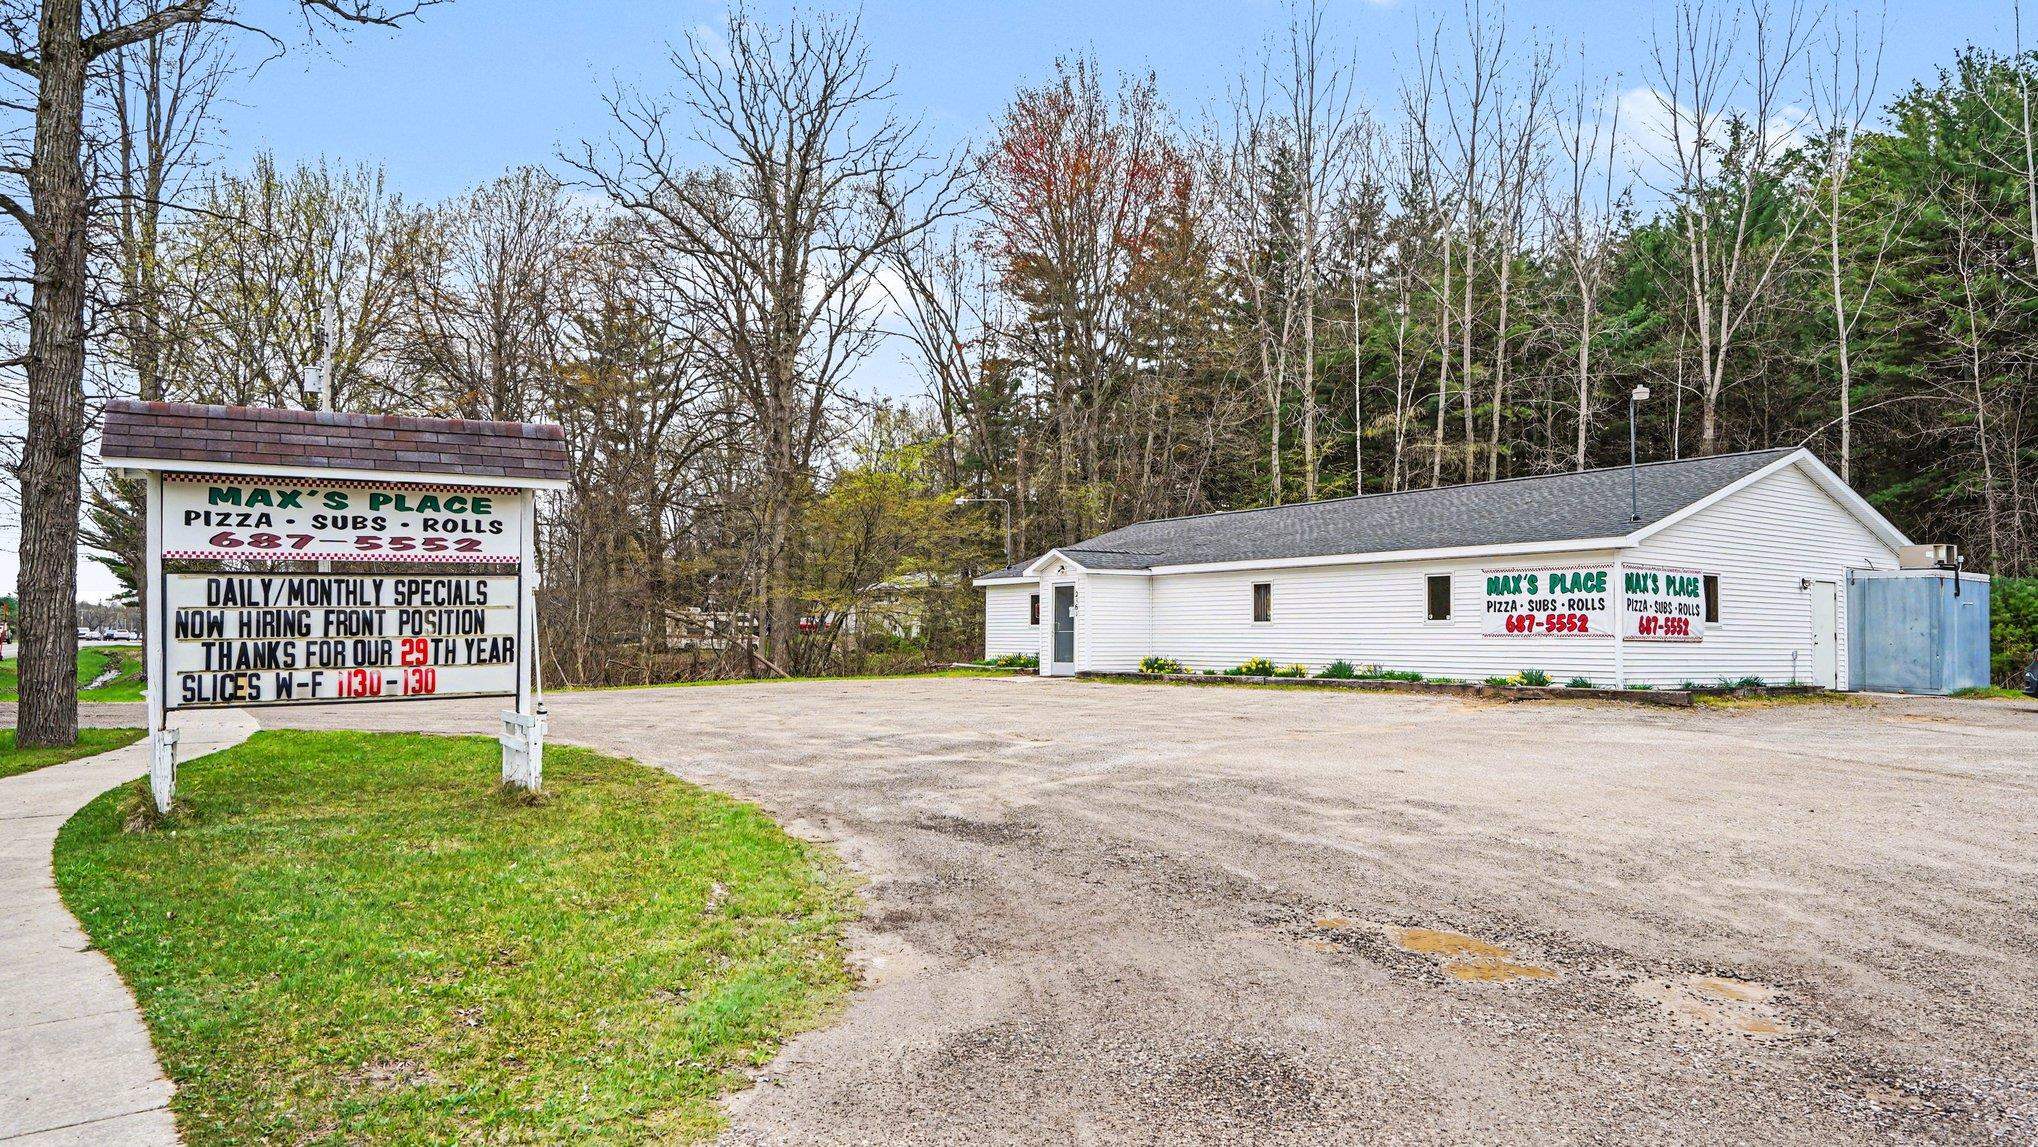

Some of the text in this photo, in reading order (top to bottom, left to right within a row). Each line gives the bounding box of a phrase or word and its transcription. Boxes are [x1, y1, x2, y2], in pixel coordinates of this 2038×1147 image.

[208, 486, 493, 515] MAX'S PLACE
[184, 510, 503, 534] PIZZA SUBS ROLLS
[208, 532, 483, 552] 687-5552
[207, 577, 488, 607] DAILY/MONTHLY SPECIALS
[1486, 571, 1607, 596] MAX'S PLACE
[1625, 572, 1699, 598] MAX'S PLACE
[1486, 597, 1605, 613] PIZZA SUBS ROLLS
[1626, 599, 1700, 617] PIZZA SUBS ROLLS
[175, 609, 485, 639] NOW HIRING FRONT POSITION
[1505, 613, 1589, 634] 687-5552
[1638, 615, 1690, 636] 687-5552
[201, 641, 296, 671] THANKS
[305, 640, 346, 668] FOR
[353, 640, 392, 667] OUR
[465, 637, 514, 664] YEAR
[182, 673, 261, 703] SLICES
[276, 671, 323, 699] W-F
